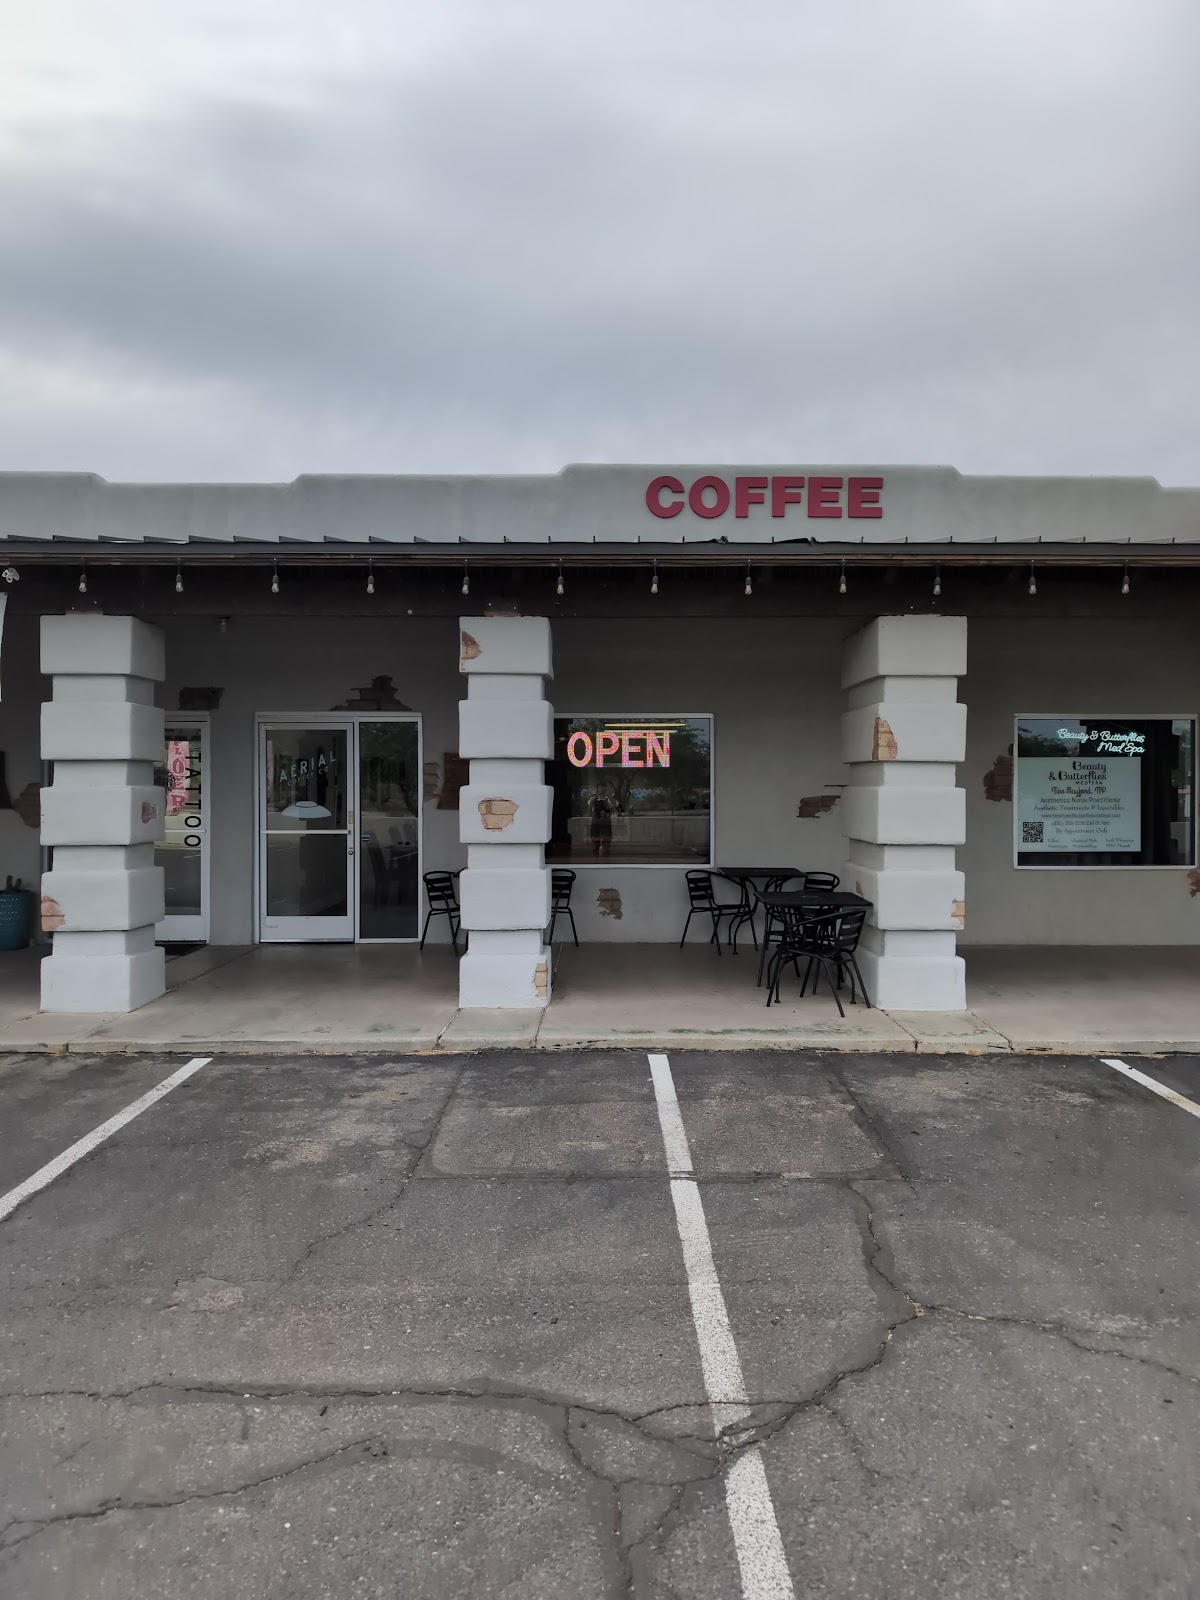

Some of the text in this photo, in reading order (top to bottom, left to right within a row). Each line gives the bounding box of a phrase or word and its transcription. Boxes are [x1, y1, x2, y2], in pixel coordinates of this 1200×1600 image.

[646, 475, 883, 518] COFFEE
[1057, 728, 1145, 745] Beauty & Butterflies
[567, 731, 670, 768] OPEN
[1097, 741, 1145, 757] Med Spa
[280, 751, 336, 783] AERIAL
[1048, 770, 1107, 783] & Butterflies
[1073, 760, 1106, 773] Beauty
[184, 752, 202, 847] TATTOO
